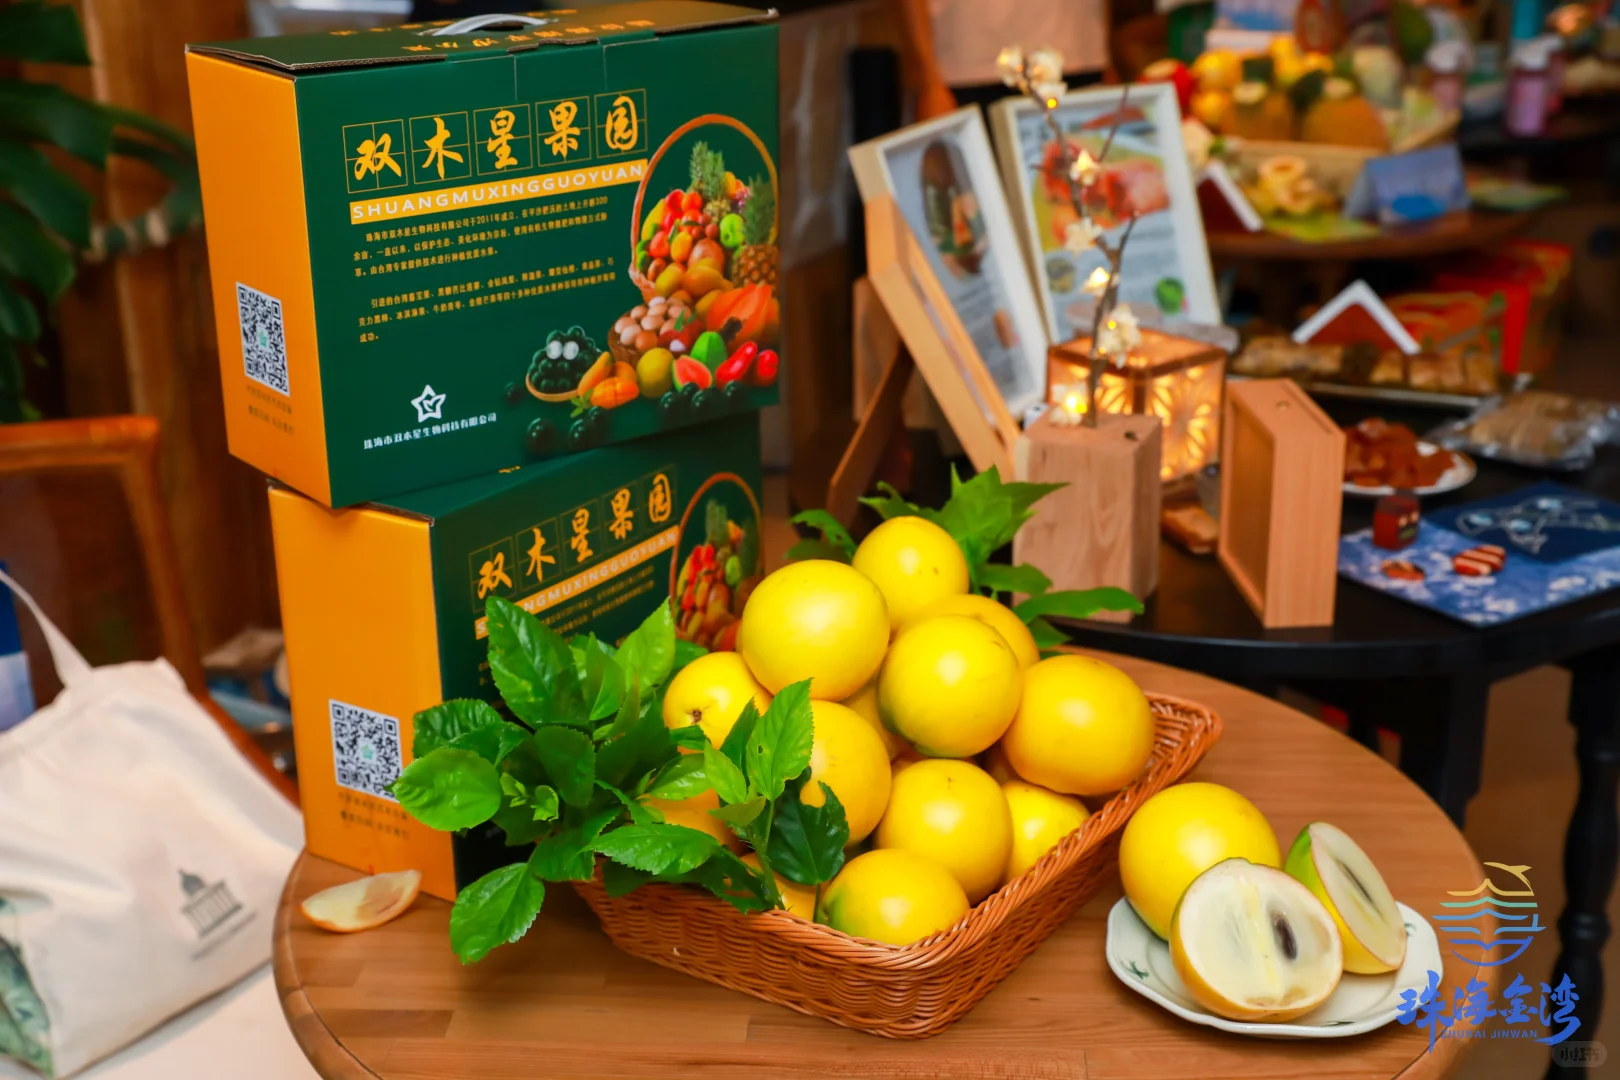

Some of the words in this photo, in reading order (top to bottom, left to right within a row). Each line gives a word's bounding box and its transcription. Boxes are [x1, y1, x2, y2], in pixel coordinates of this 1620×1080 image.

[354, 96, 638, 180] 双木星果园
[353, 164, 642, 219] SHUANGMUXINGGUOYUAN
[363, 412, 497, 449] 珠海市双木星生物科技有限公司
[477, 473, 672, 600] 双木星果园
[476, 531, 678, 634] SNGMUXINGGUOYUAN
